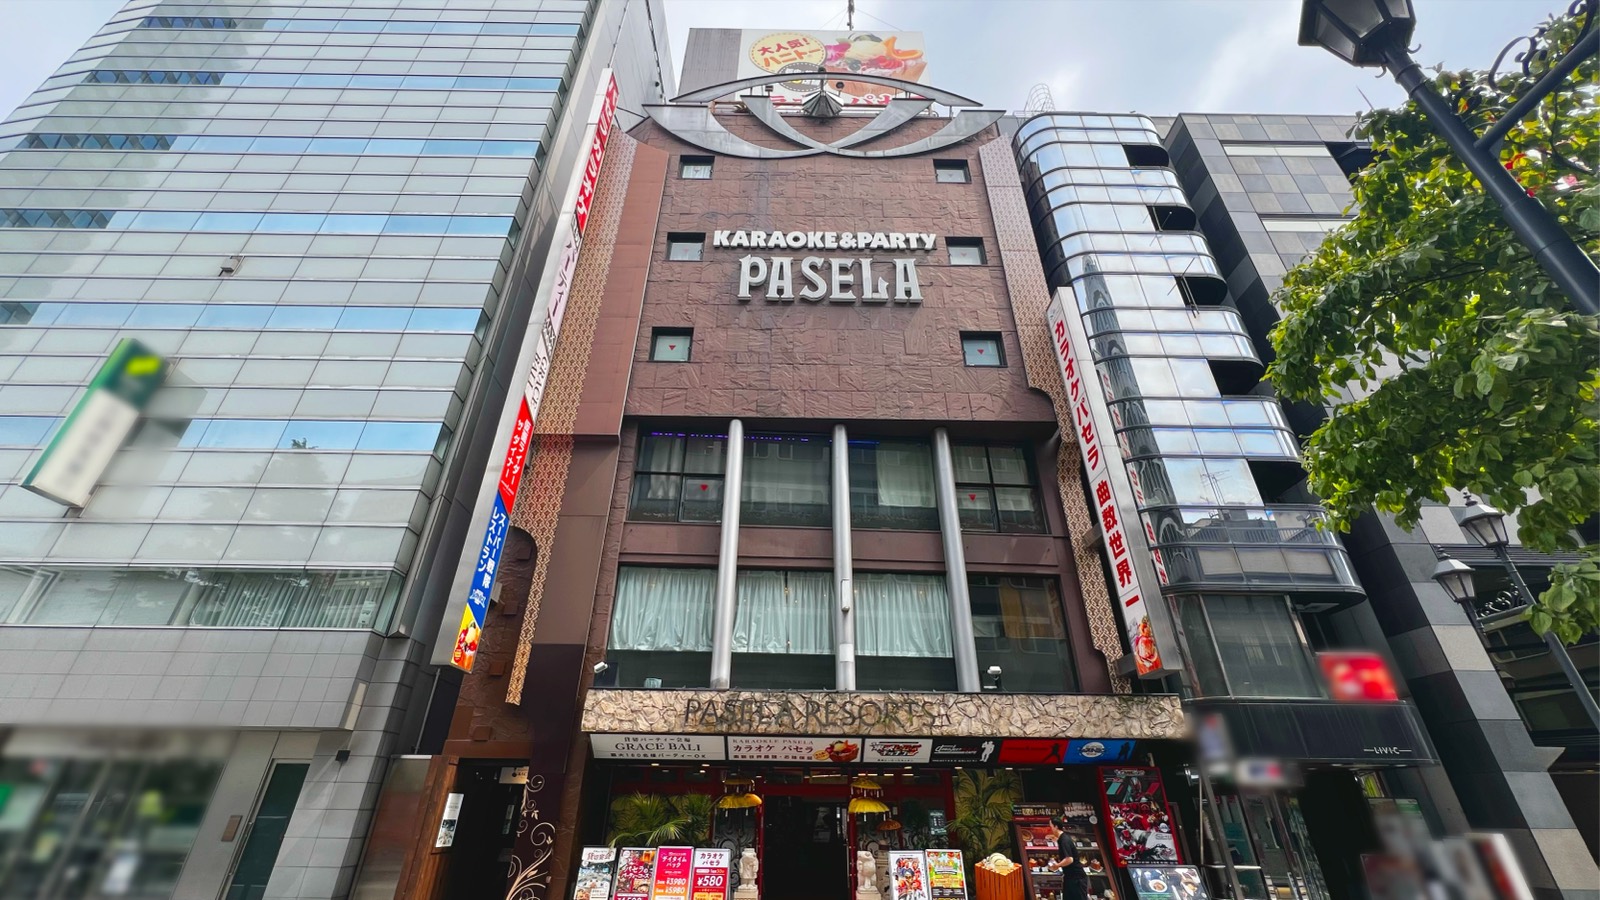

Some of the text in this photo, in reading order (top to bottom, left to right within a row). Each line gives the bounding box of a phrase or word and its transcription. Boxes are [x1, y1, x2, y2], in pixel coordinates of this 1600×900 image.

[763, 48, 821, 68] ハニトー
[713, 230, 937, 250] KARAOKE&PARTY
[737, 254, 923, 303] PASELA
[1055, 319, 1100, 471] カラオケパセラ
[1096, 479, 1140, 608] 曲数世界一
[478, 506, 500, 572] レストラン
[684, 699, 799, 727] PASELA
[615, 742, 701, 752] GRACE BALI
[733, 744, 814, 753] カラオケ パセラ
[700, 852, 724, 860] カラオケ
[697, 875, 724, 887] ¥580
